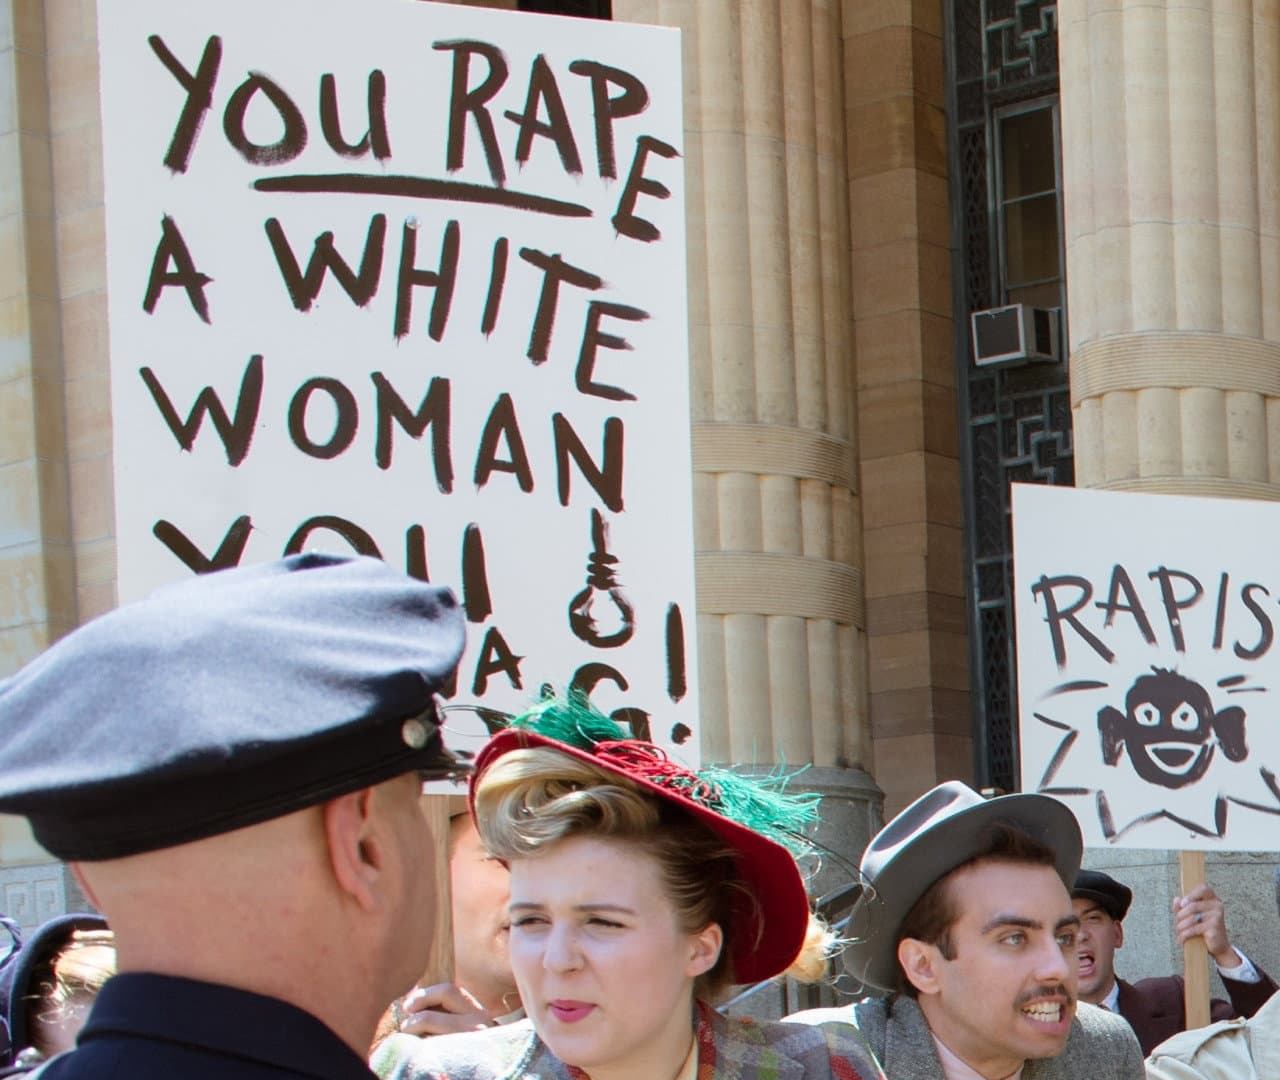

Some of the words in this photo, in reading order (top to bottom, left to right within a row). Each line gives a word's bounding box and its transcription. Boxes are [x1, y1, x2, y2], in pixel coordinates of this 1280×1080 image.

[148, 34, 392, 174] YOU
[432, 39, 682, 243] RAPE
[143, 213, 213, 324] A
[265, 213, 651, 402] WHITE
[139, 354, 625, 513] WOMAN
